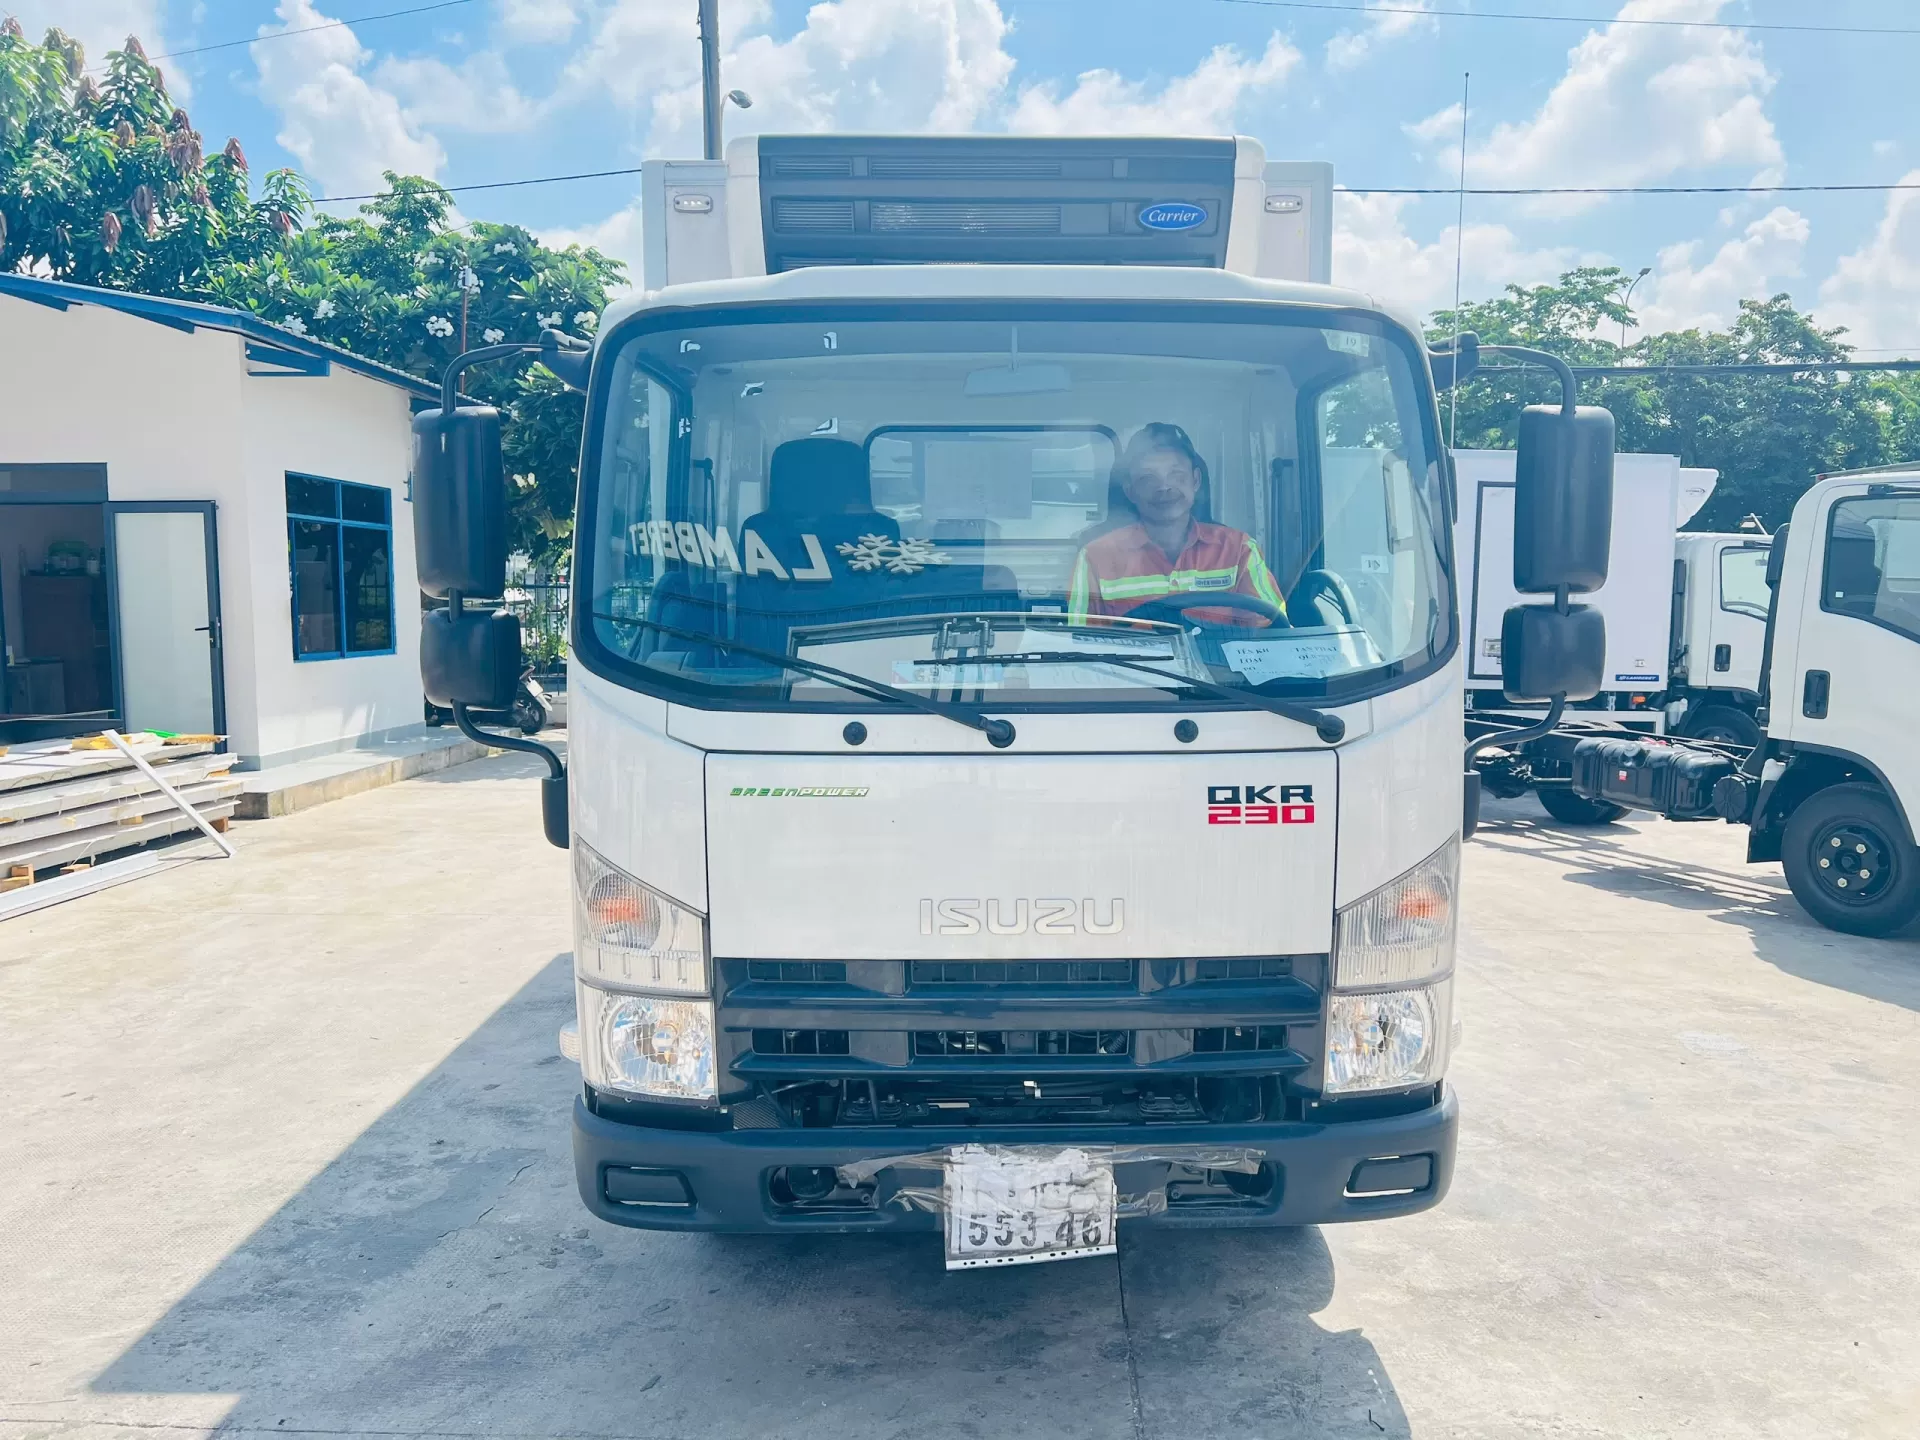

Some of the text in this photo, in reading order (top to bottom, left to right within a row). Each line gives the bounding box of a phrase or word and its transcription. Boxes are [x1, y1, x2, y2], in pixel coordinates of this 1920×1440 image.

[1148, 209, 1199, 222] Carrier
[729, 786, 871, 798] GREENPOWER
[1207, 784, 1315, 805] QKR
[1208, 804, 1315, 825] 230
[919, 898, 1125, 935] ISUZU
